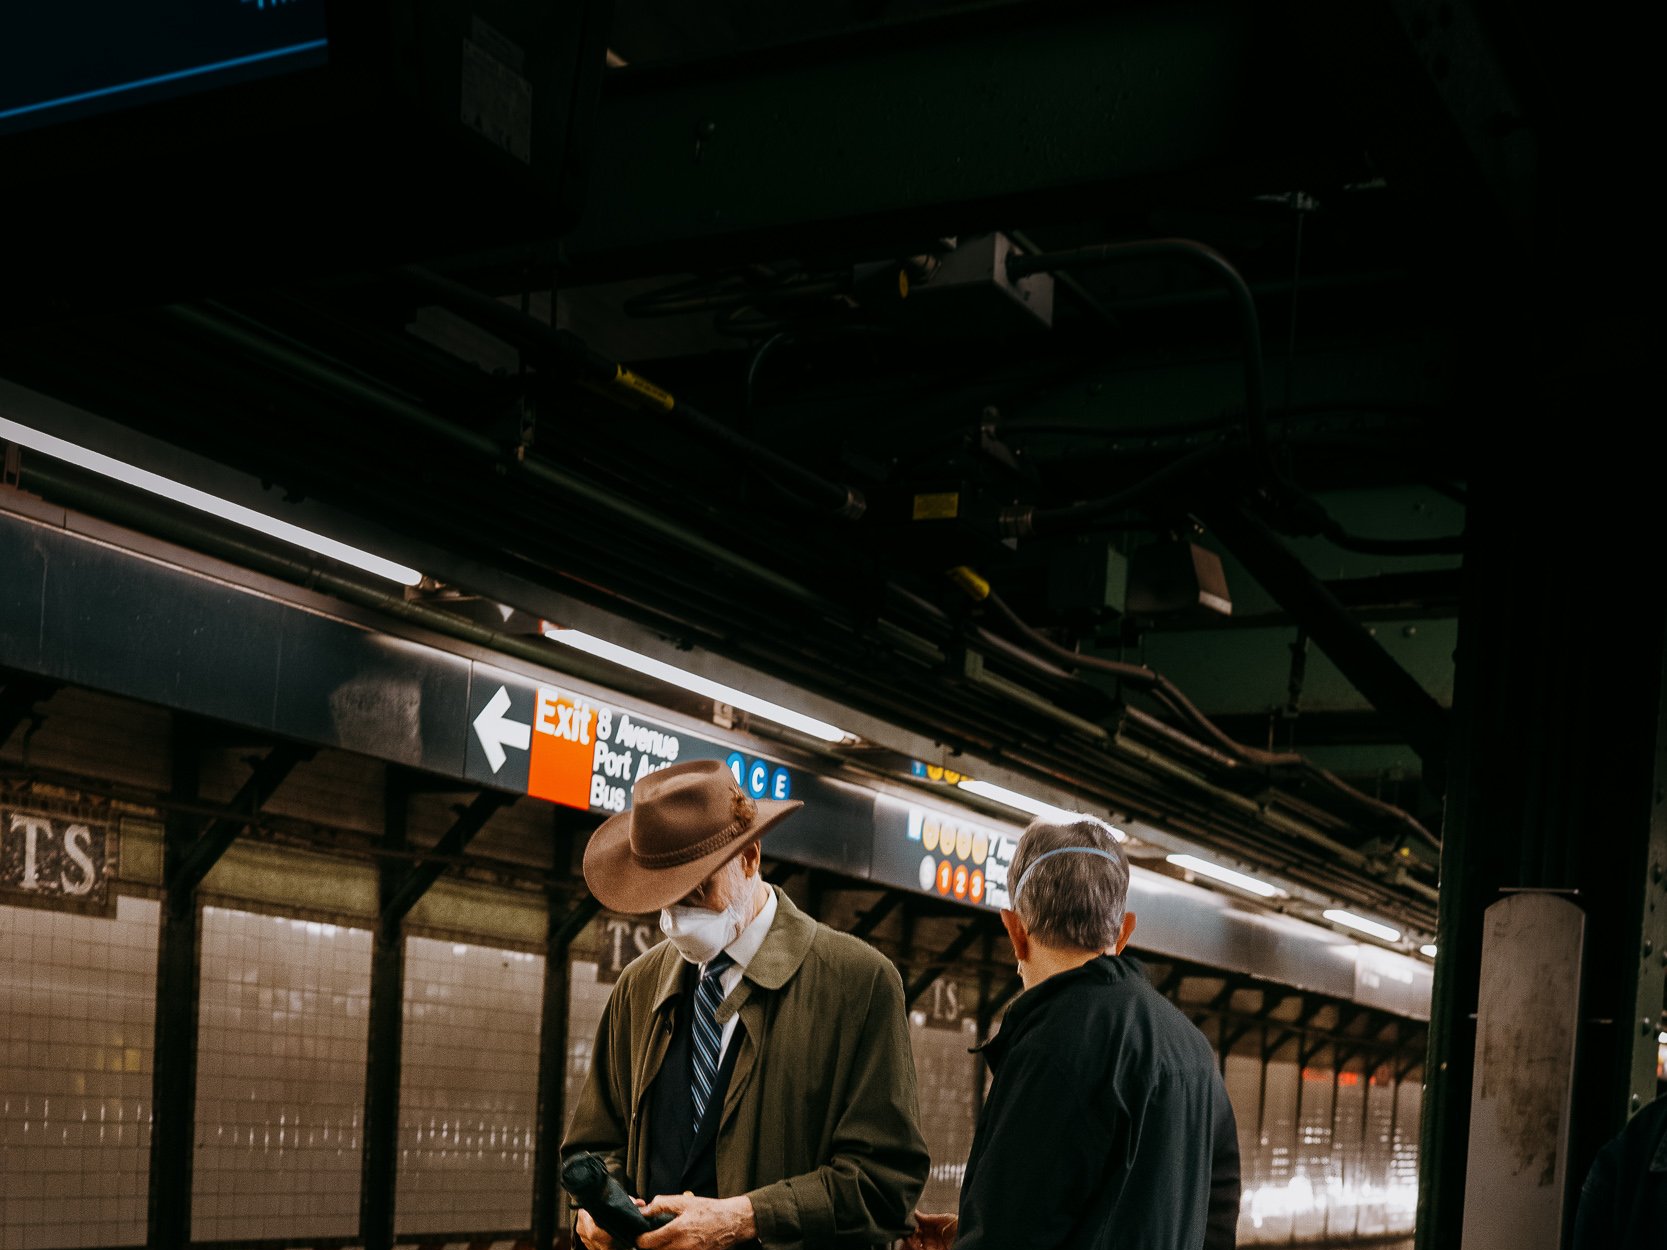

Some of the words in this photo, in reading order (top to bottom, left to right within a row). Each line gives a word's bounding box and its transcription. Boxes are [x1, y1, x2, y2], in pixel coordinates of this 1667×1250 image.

[536, 687, 592, 746] Exit
[596, 707, 612, 741] 8
[614, 714, 679, 761] Avenue
[593, 740, 632, 780] Port
[590, 773, 626, 813] Bus
[751, 766, 765, 793] C
[774, 773, 787, 799] E
[9, 812, 96, 896] TS
[941, 866, 950, 889] 1
[955, 871, 967, 894] 2
[970, 875, 982, 898] 3
